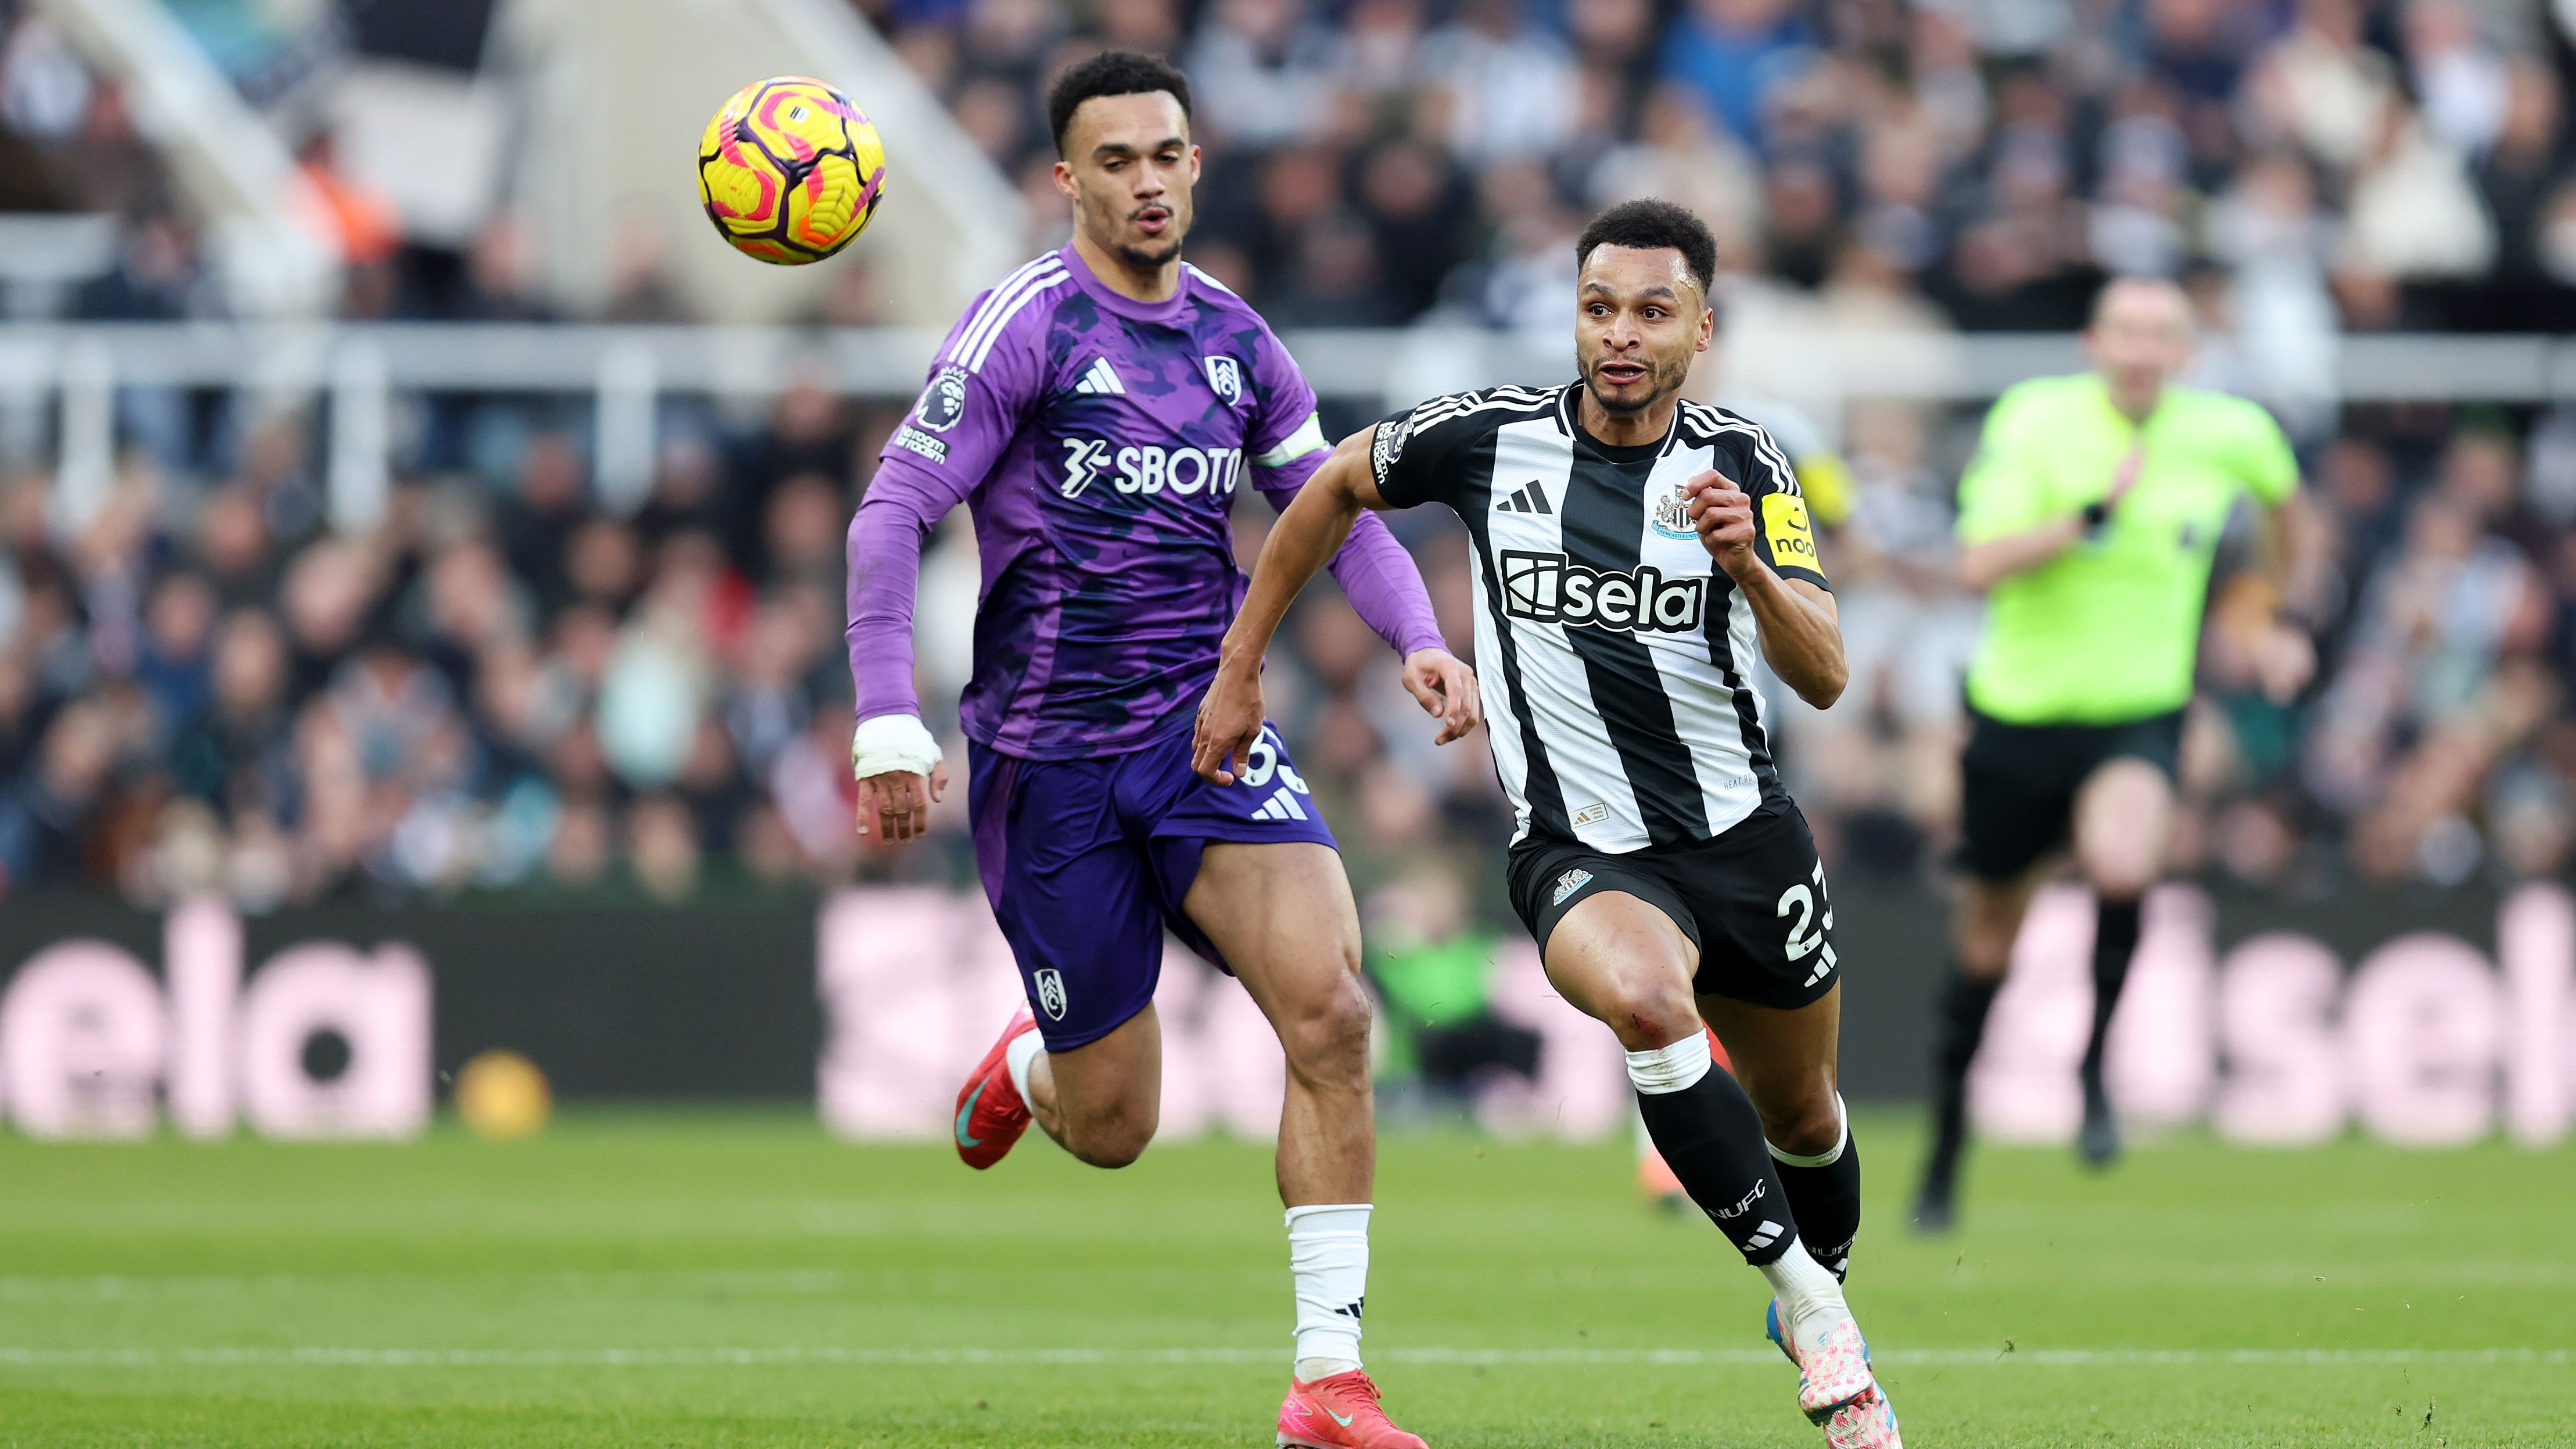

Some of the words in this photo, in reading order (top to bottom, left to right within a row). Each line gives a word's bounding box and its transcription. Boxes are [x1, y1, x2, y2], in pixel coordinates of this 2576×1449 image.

[912, 430, 945, 453] room
[1380, 439, 1389, 475] room
[1373, 441, 1386, 484] racism
[1563, 573, 1697, 626] sela
[1707, 1178, 1766, 1219] NUFC
